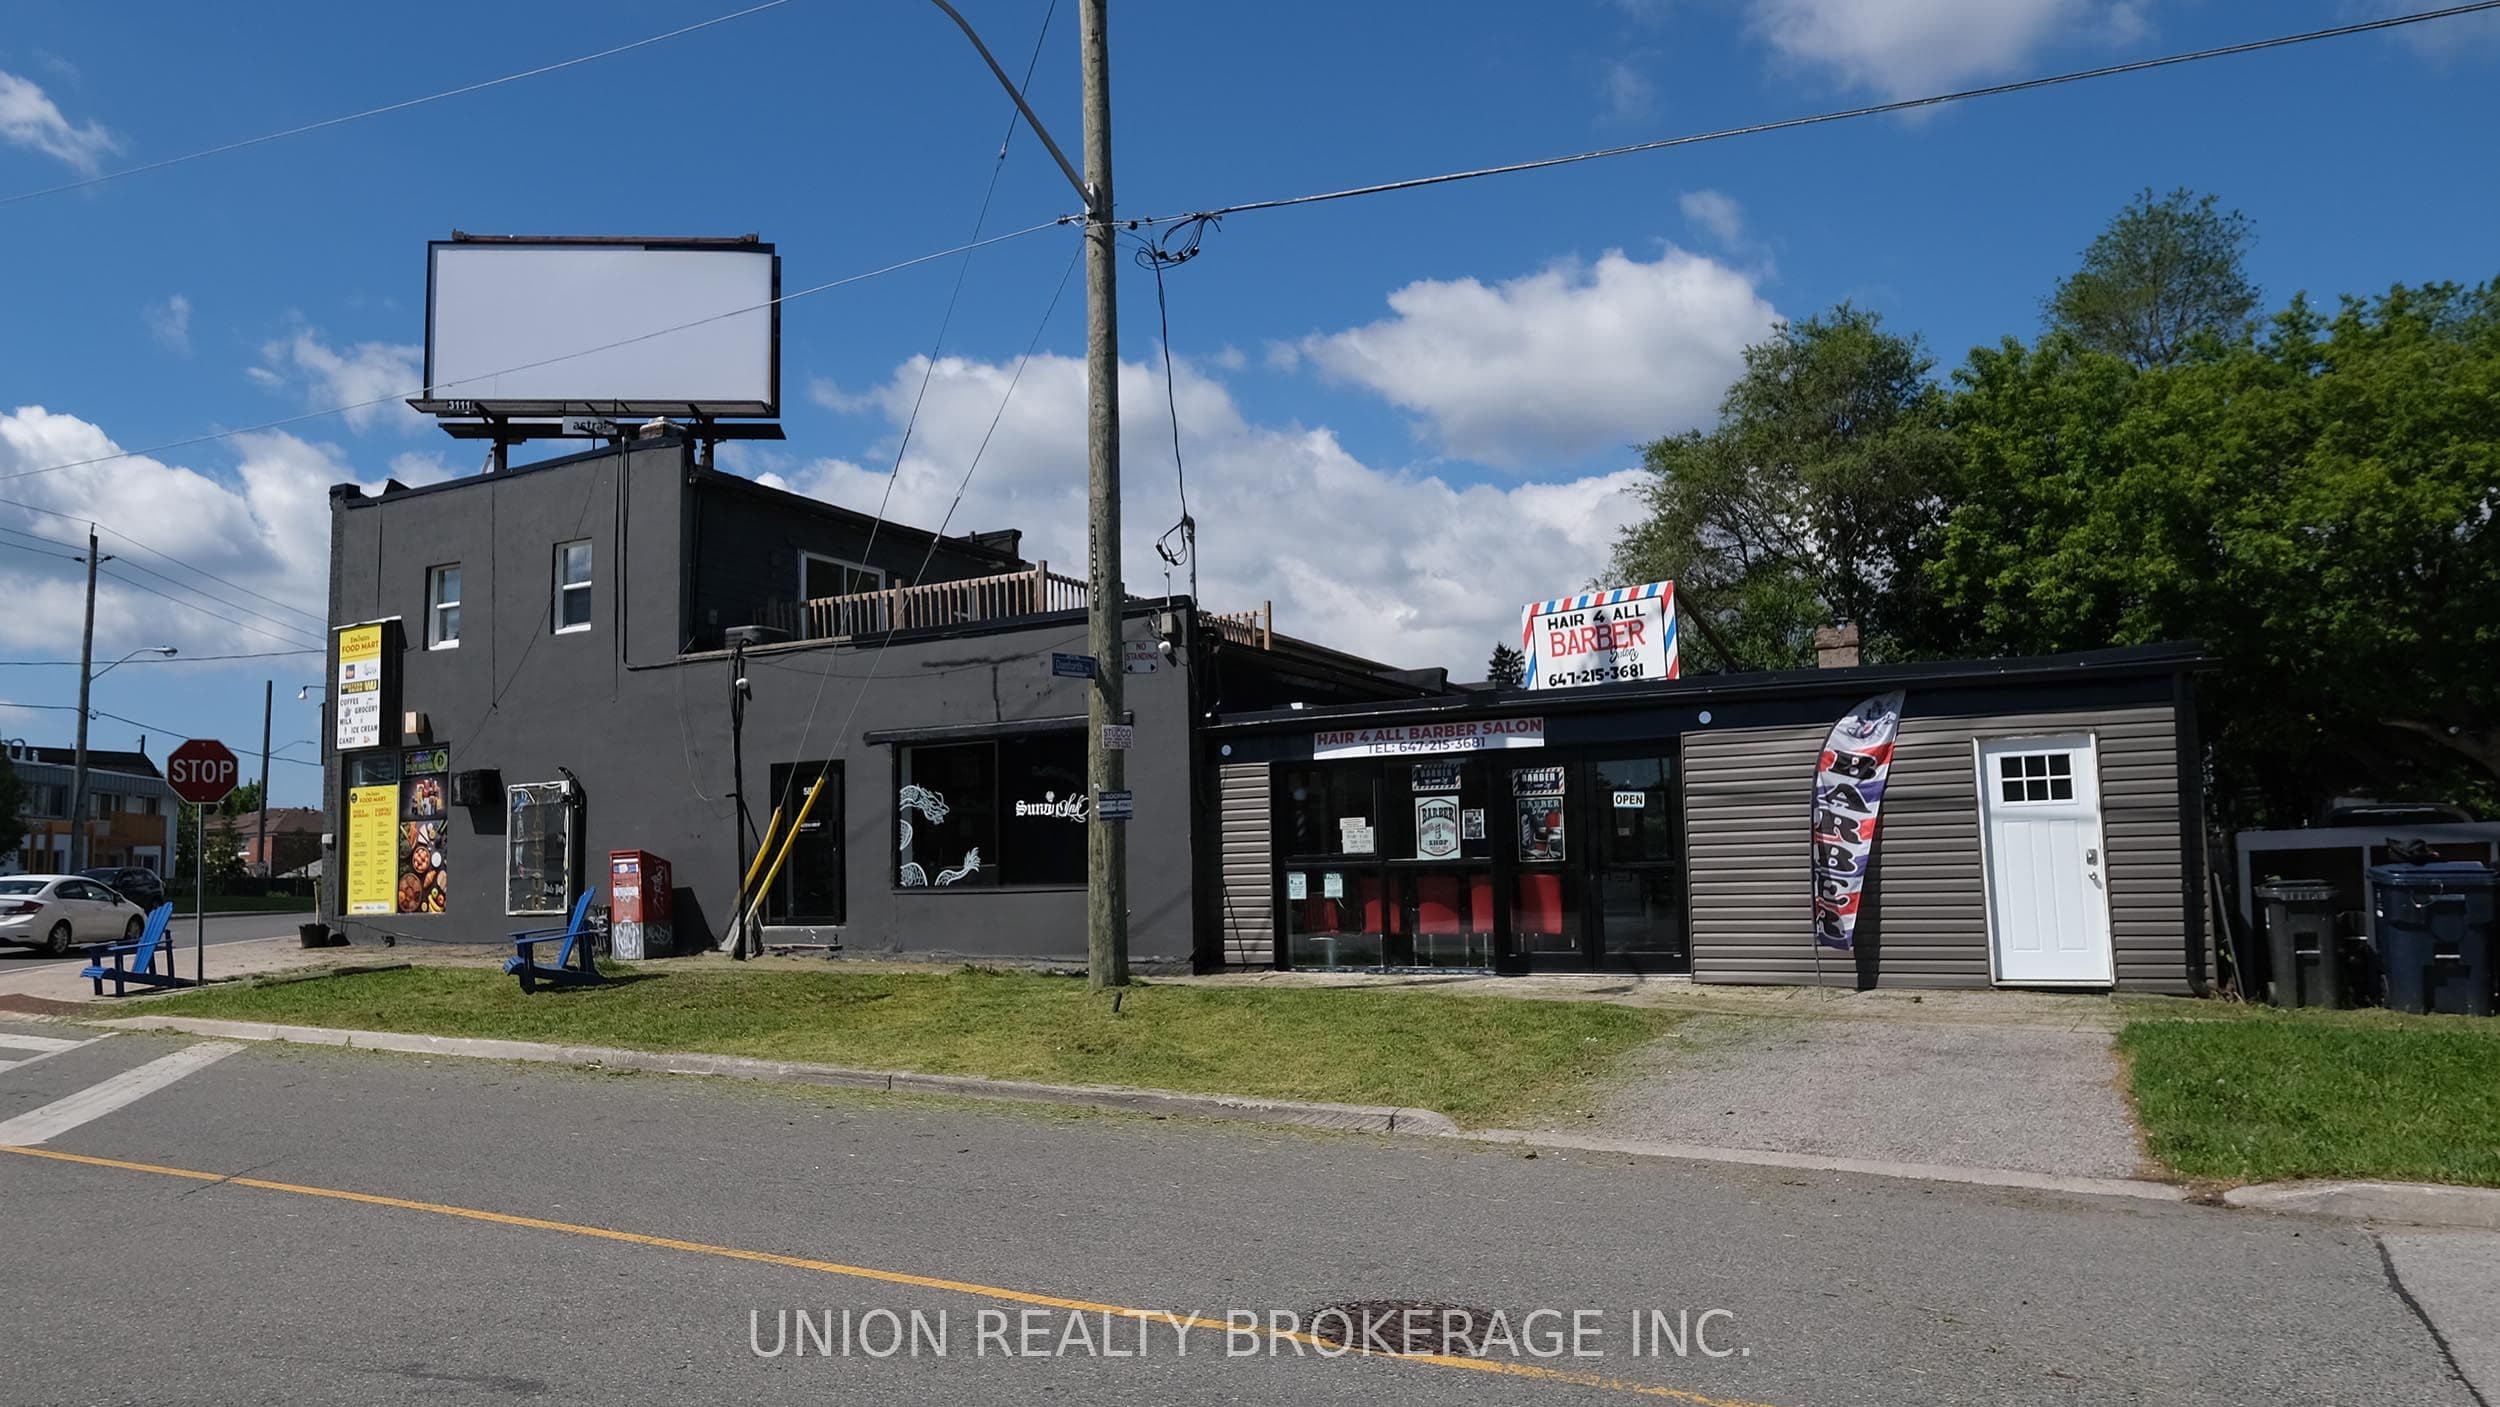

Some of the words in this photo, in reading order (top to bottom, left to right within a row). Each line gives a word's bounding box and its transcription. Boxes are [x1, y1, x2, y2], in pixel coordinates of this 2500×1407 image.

[448, 401, 471, 411] 3111
[1547, 613, 1585, 630] HAIR
[1593, 610, 1605, 623] 4
[1613, 604, 1646, 621] ALL
[1550, 620, 1646, 658] BARBER
[342, 644, 360, 654] FOOD
[361, 640, 379, 650] MART
[1136, 642, 1147, 651] NO
[1126, 652, 1158, 660] STANDING
[1549, 663, 1644, 687] 647-215-3681
[340, 697, 359, 706] COFFEE
[355, 705, 378, 714] GROCERY
[351, 726, 360, 734] ICE
[361, 724, 378, 733] CREAM
[1104, 727, 1132, 738] STUCCO
[1317, 732, 1354, 745] HAIR
[1359, 731, 1369, 743] 4
[1375, 729, 1404, 742] ALL
[1409, 723, 1478, 740] BARBER
[1482, 719, 1542, 735] SALON
[339, 737, 356, 745] CANDY
[1367, 743, 1395, 754] TEL:
[1399, 737, 1486, 752] 647-215-3681
[172, 759, 235, 783] STOP
[1521, 772, 1555, 782] BARBER
[1521, 799, 1560, 808] BARBER
[1615, 794, 1644, 805] OPEN
[1422, 806, 1456, 825] BARBER
[1812, 751, 1877, 940] BARBER
